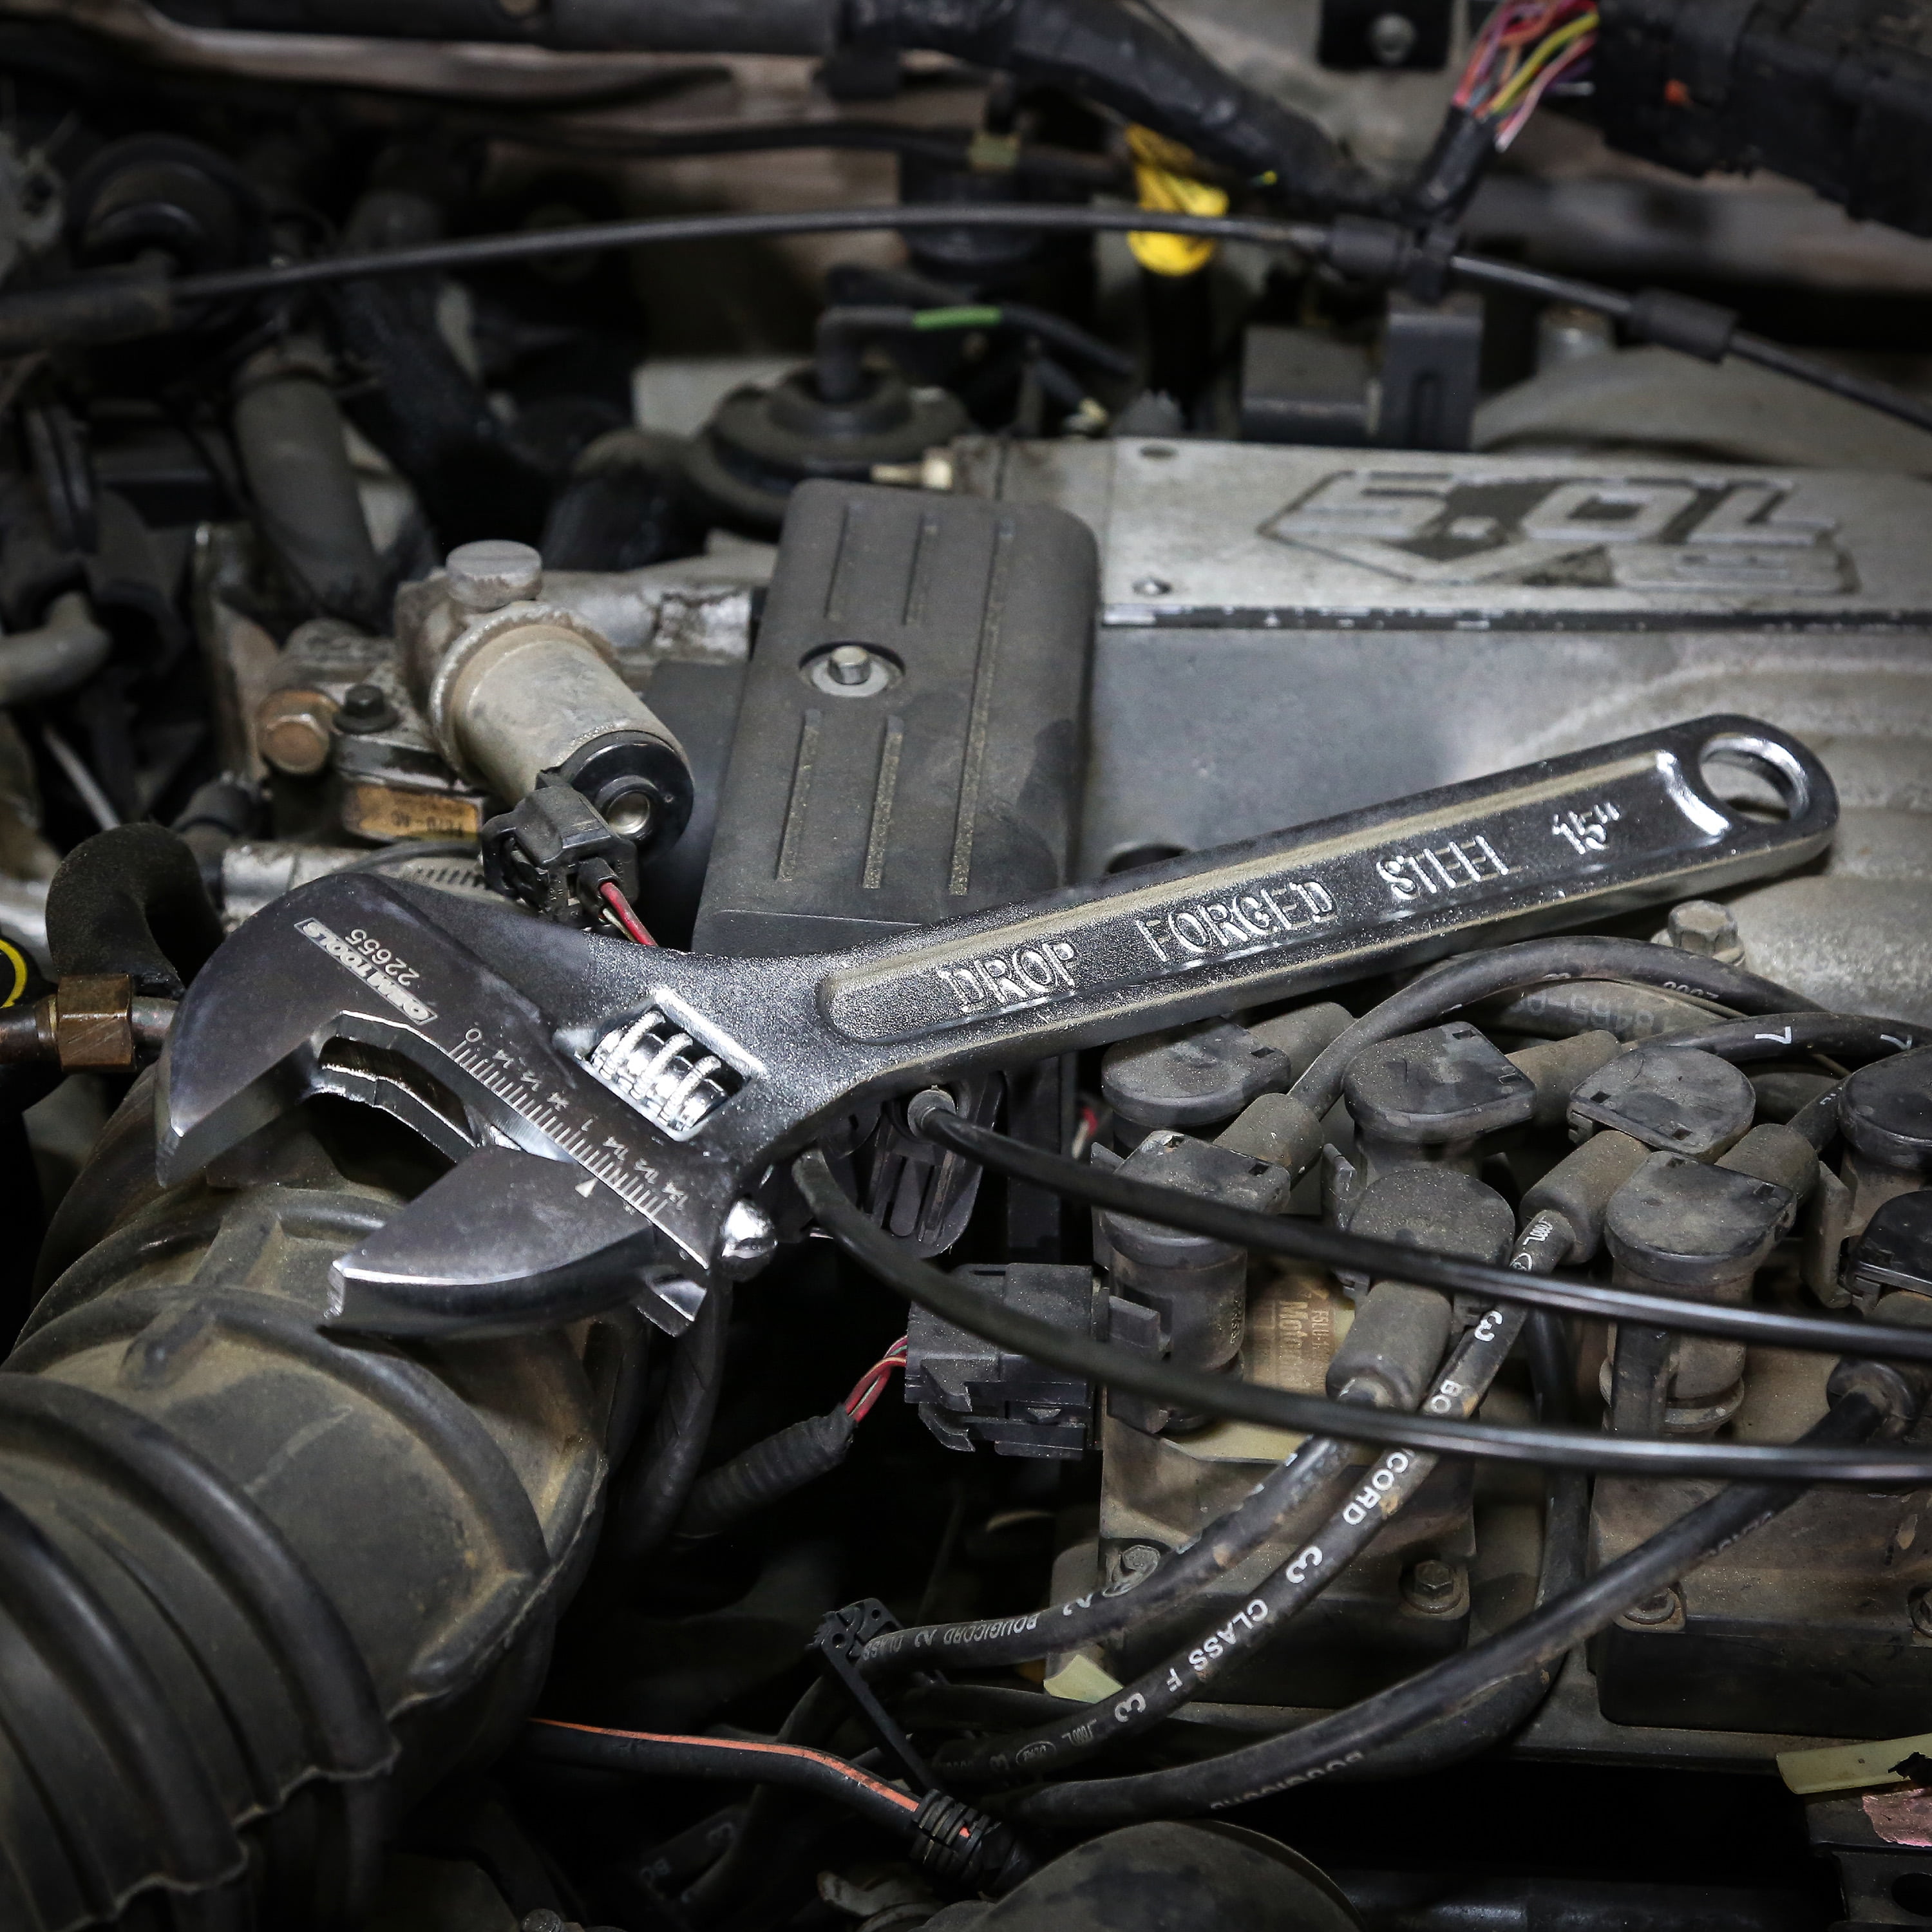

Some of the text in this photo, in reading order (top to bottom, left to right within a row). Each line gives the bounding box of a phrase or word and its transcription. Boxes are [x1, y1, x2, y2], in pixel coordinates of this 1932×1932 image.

[345, 928, 419, 987] 22655
[937, 939, 1077, 1013] DROP
[1135, 880, 1338, 962] FORGED
[1473, 1311, 1503, 1342] 3
[1285, 1546, 1323, 1584] 3
[1188, 1598, 1268, 1672] CLASS
[1166, 1667, 1184, 1692] F
[1115, 1692, 1147, 1723] 3
